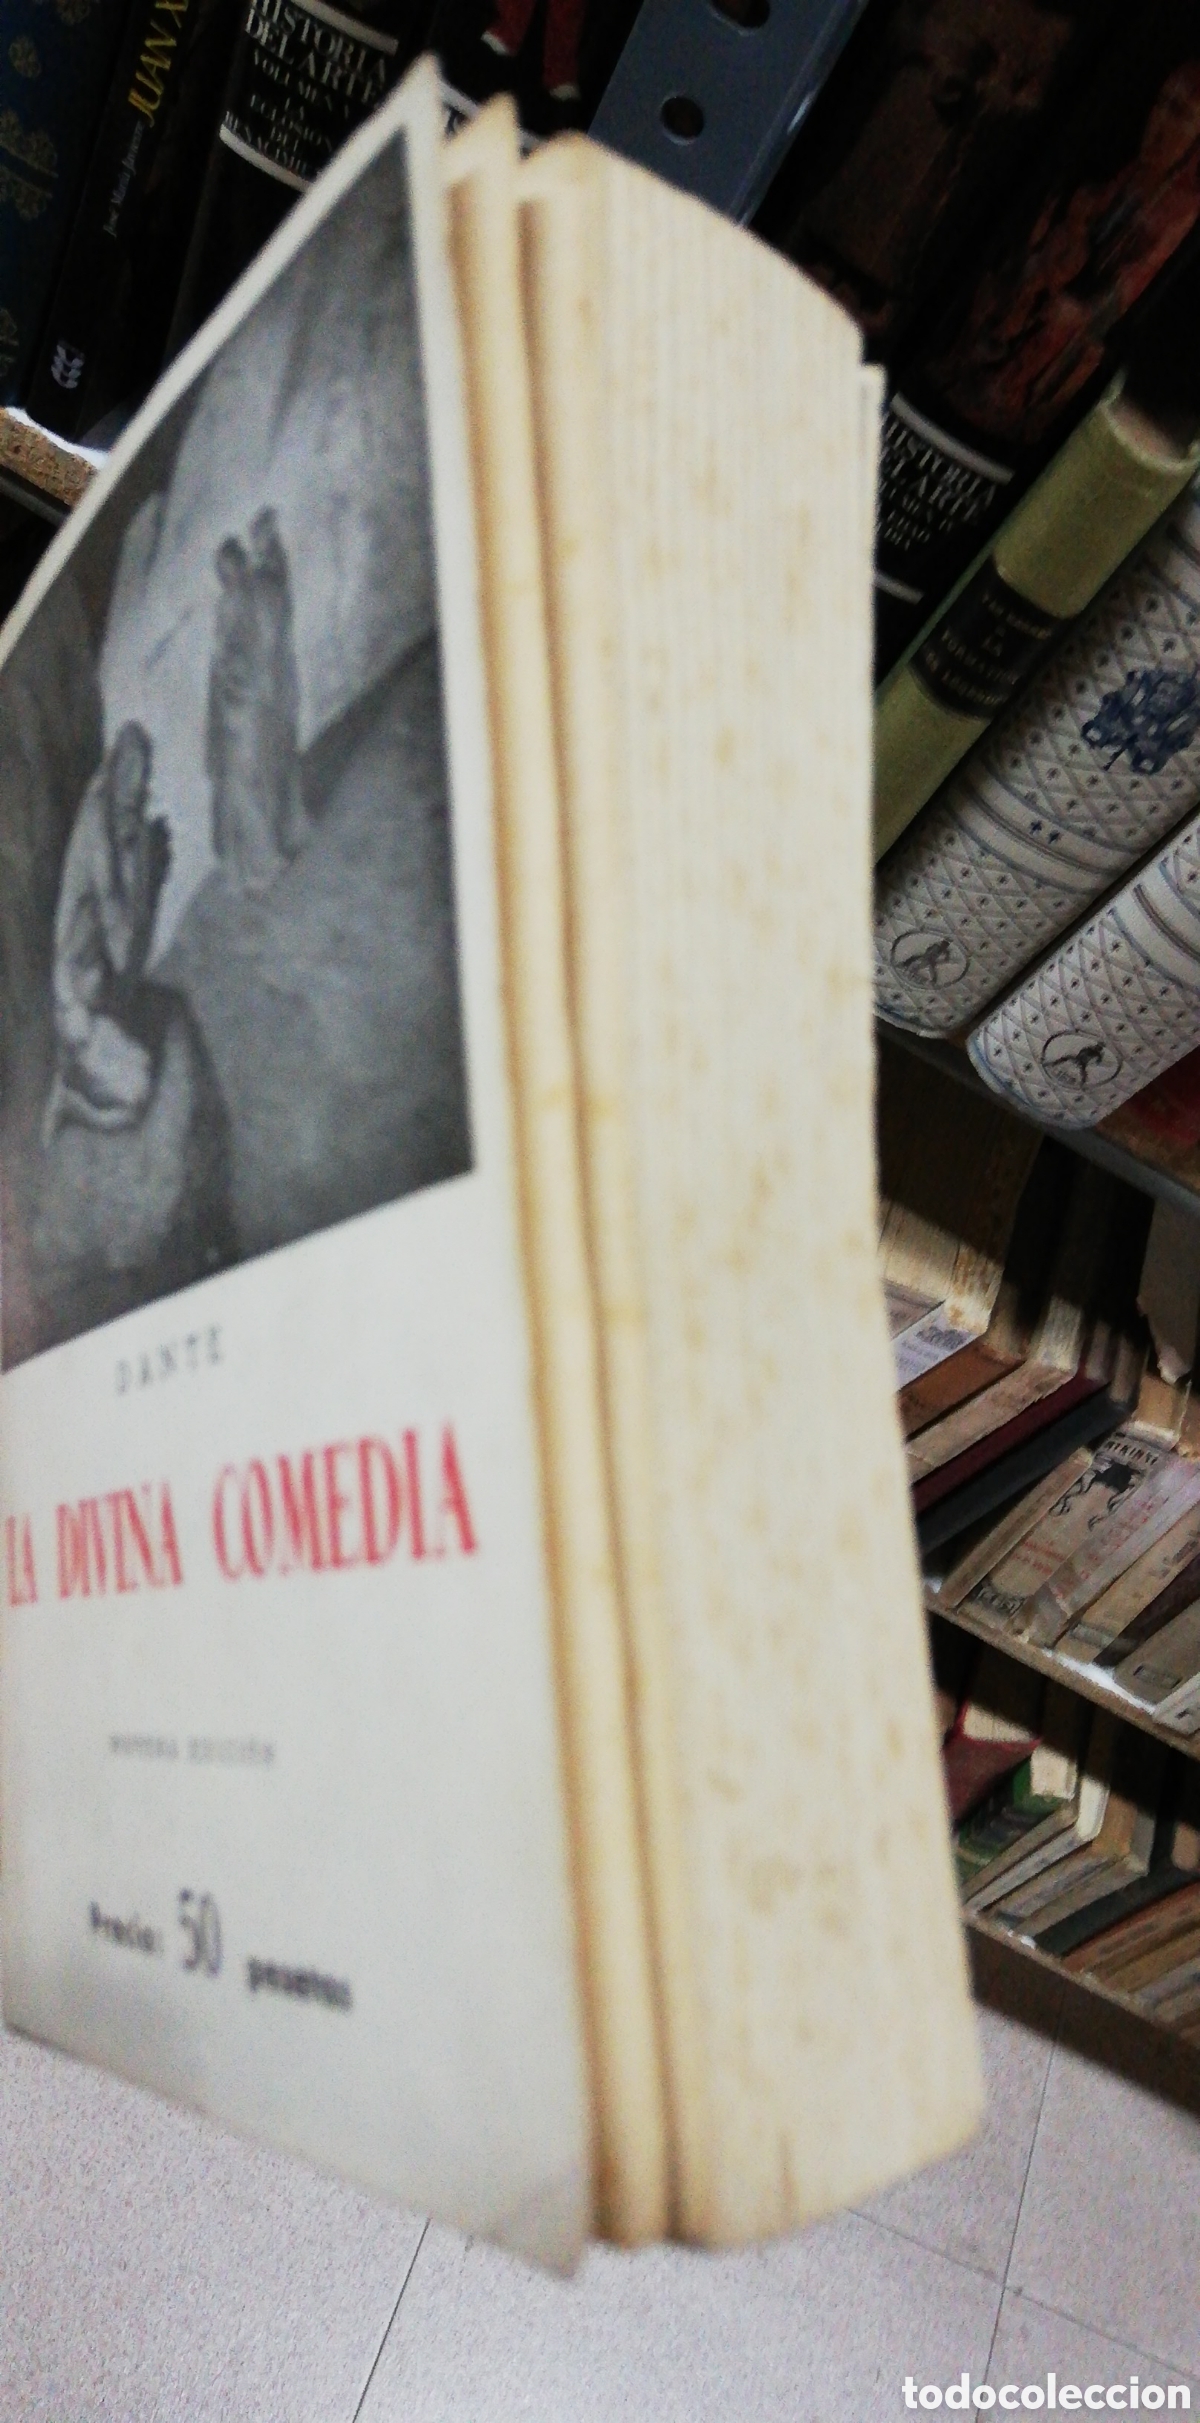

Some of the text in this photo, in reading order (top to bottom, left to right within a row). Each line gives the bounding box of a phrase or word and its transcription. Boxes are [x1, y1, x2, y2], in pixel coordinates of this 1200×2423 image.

[128, 19, 177, 128] JUAN
[245, 10, 385, 105] DEL ARTE
[252, 0, 388, 83] HISTORIA
[116, 1328, 224, 1394] DANTE
[4, 1423, 478, 1606] LA DIVINA COMEDIA
[179, 1889, 223, 1977] 50
